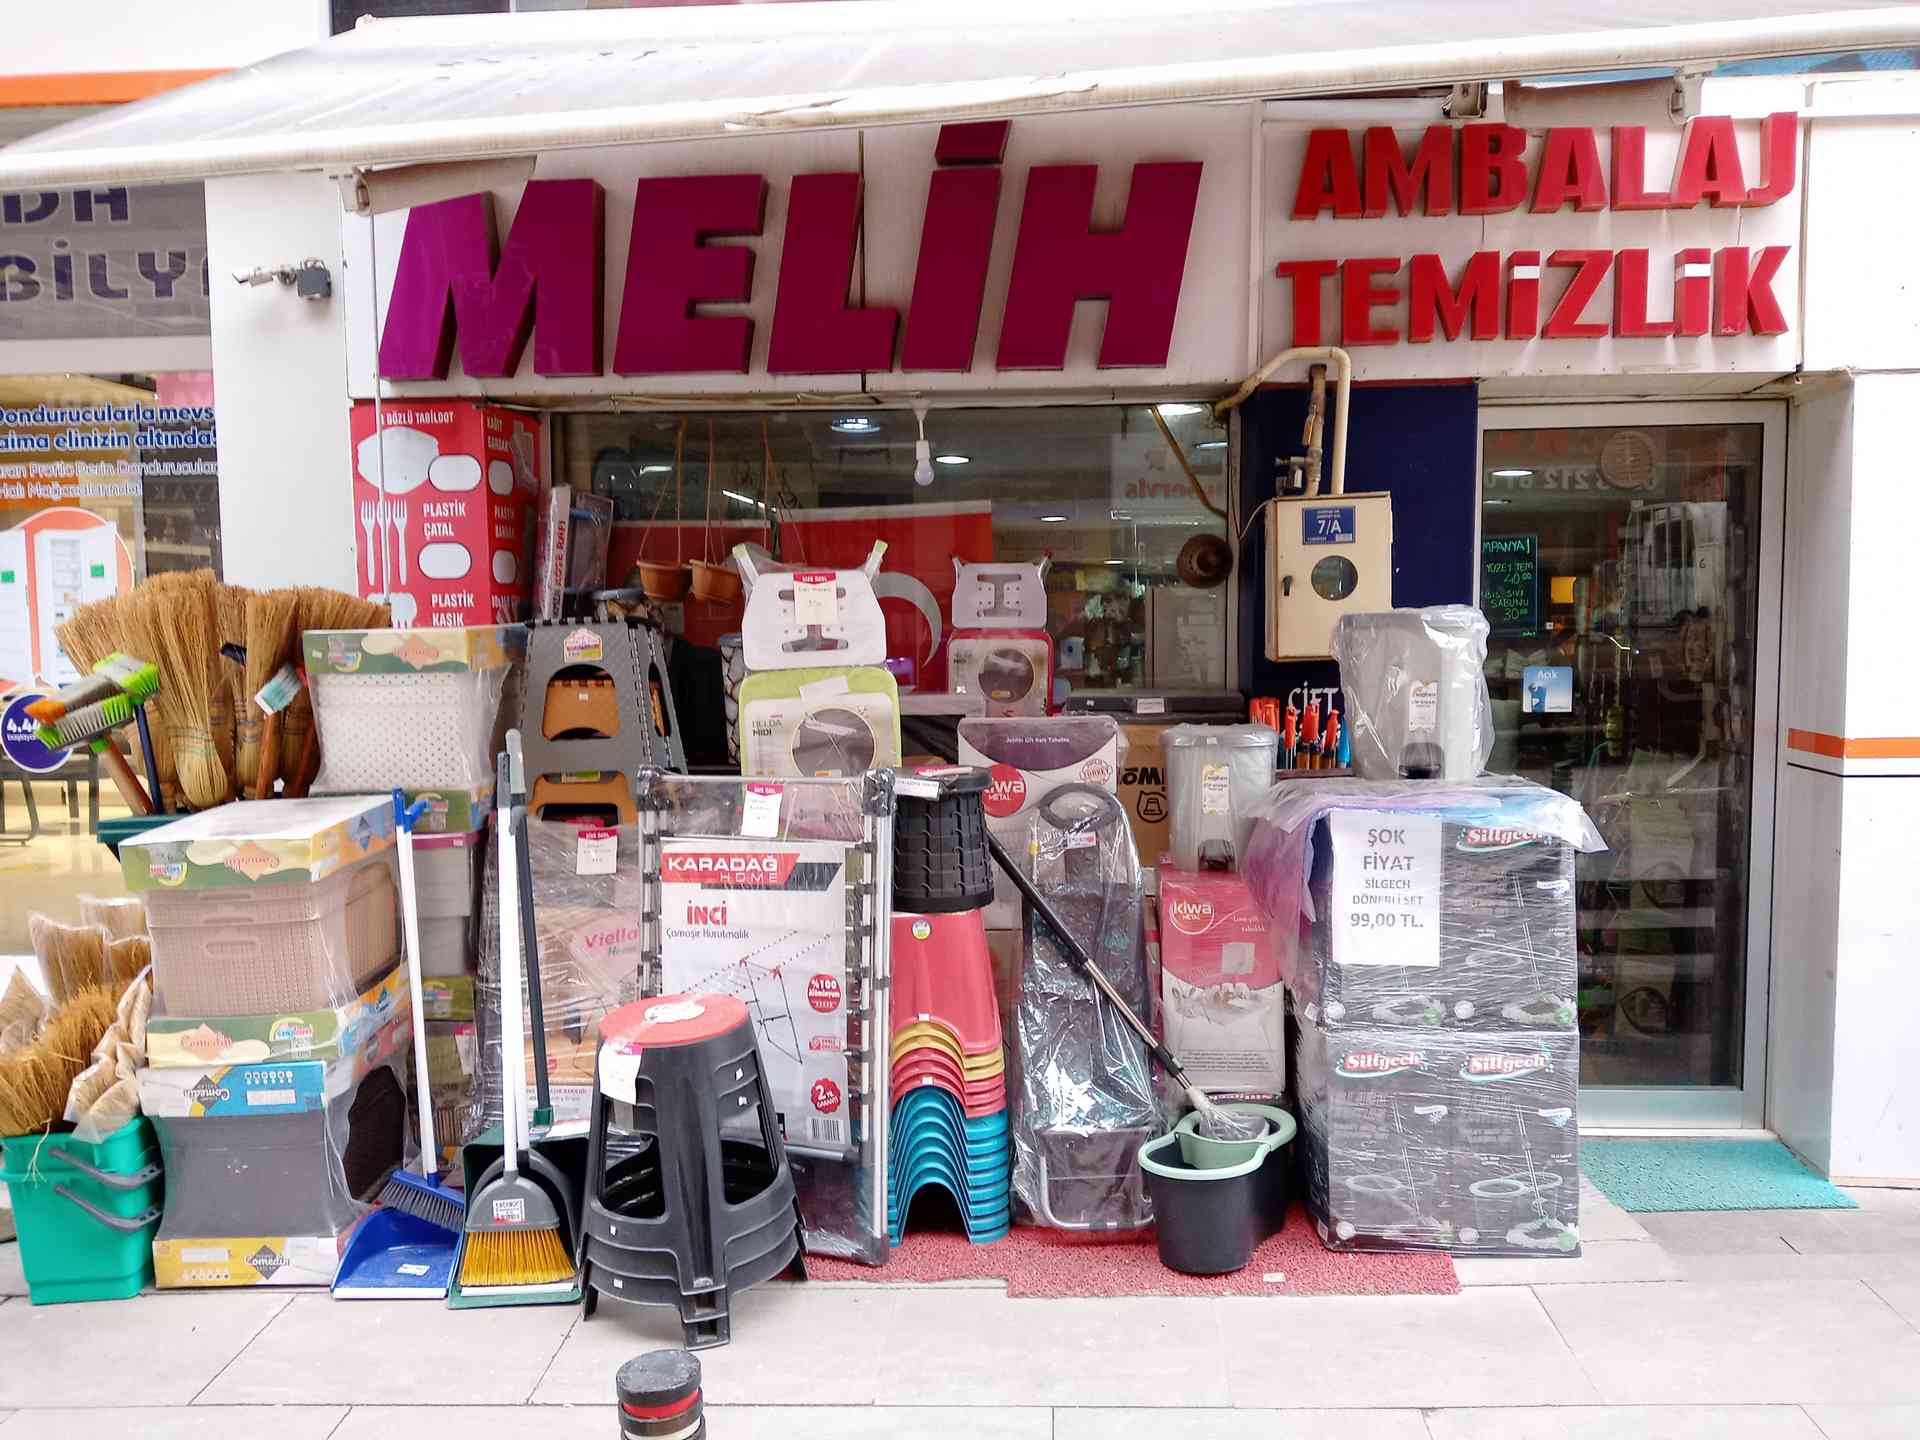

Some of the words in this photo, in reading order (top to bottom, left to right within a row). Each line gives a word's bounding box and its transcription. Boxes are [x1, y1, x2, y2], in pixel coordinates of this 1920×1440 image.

[1290, 111, 1798, 220] AMBALAJ
[378, 120, 1204, 380] MELİH
[0, 240, 209, 301] BİLY
[1277, 246, 1792, 346] TEMİZLİK
[54, 428, 130, 448] elinizin
[423, 501, 467, 518] PLASTİK
[423, 522, 455, 541] ÇATAL
[1317, 518, 1342, 536] 7/A
[431, 589, 475, 607] PLASTİK
[1367, 828, 1406, 848] ŞOK
[668, 854, 778, 872] KARADAĞ
[1362, 851, 1416, 871] FİYAT
[720, 873, 778, 882] HOME
[1364, 877, 1411, 889] SİLGECH
[687, 899, 727, 926] İNCİ
[1350, 912, 1397, 929] 99,00
[1400, 912, 1424, 928] TL.
[811, 979, 837, 990] %100
[815, 1084, 827, 1101] 2
